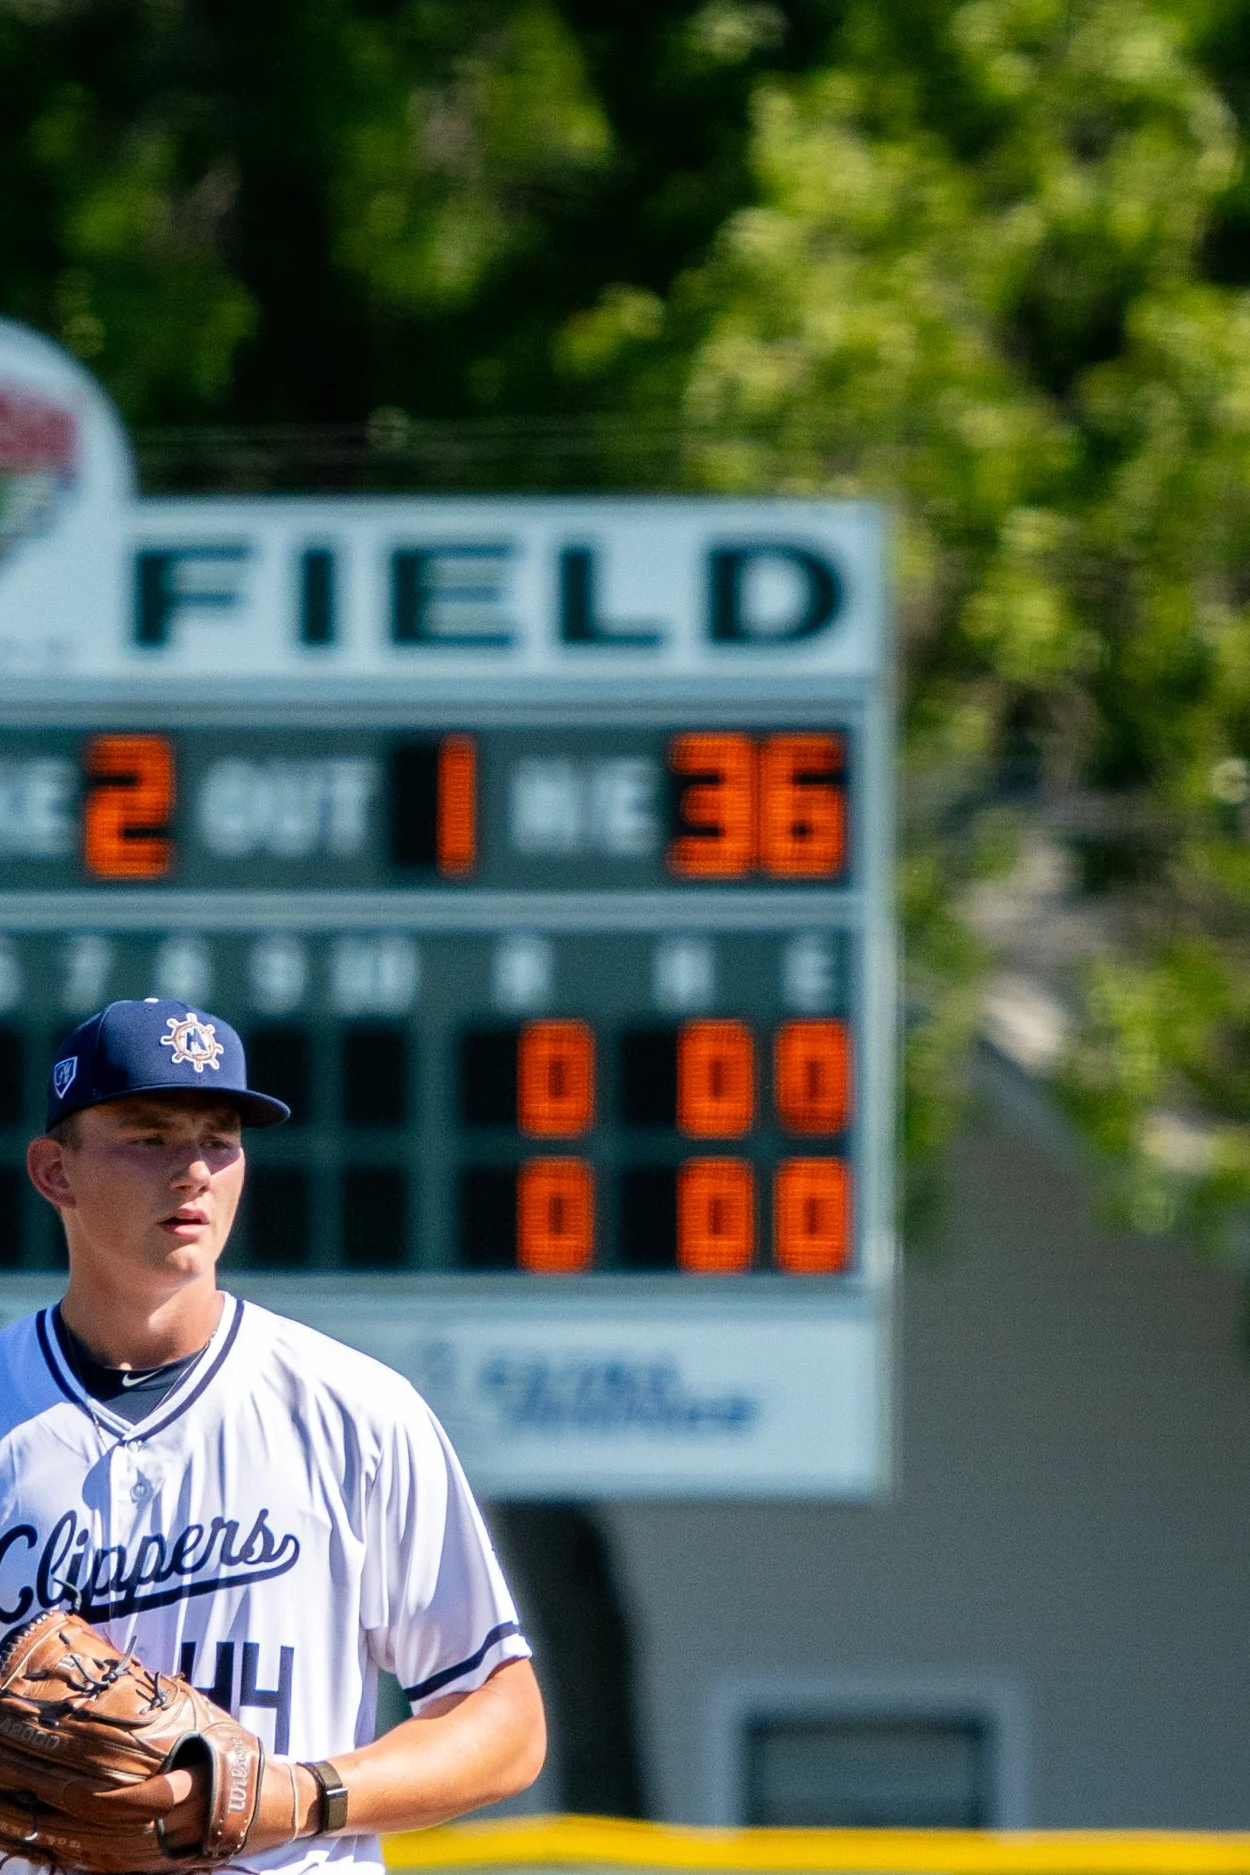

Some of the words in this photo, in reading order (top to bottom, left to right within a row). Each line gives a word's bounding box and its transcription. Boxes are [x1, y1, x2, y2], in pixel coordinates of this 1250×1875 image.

[132, 542, 844, 648] FIELD
[82, 733, 174, 880] 2
[197, 757, 375, 857] OUT
[436, 732, 476, 877] 1
[666, 731, 846, 880] 36
[516, 1018, 596, 1139] 0
[675, 1018, 753, 1139] 0
[773, 1017, 849, 1138] 0
[516, 1156, 596, 1275] 0
[675, 1156, 753, 1275] 0
[773, 1156, 850, 1275] 0
[179, 1640, 295, 1756] 44
[228, 1735, 248, 1813] Wilson
